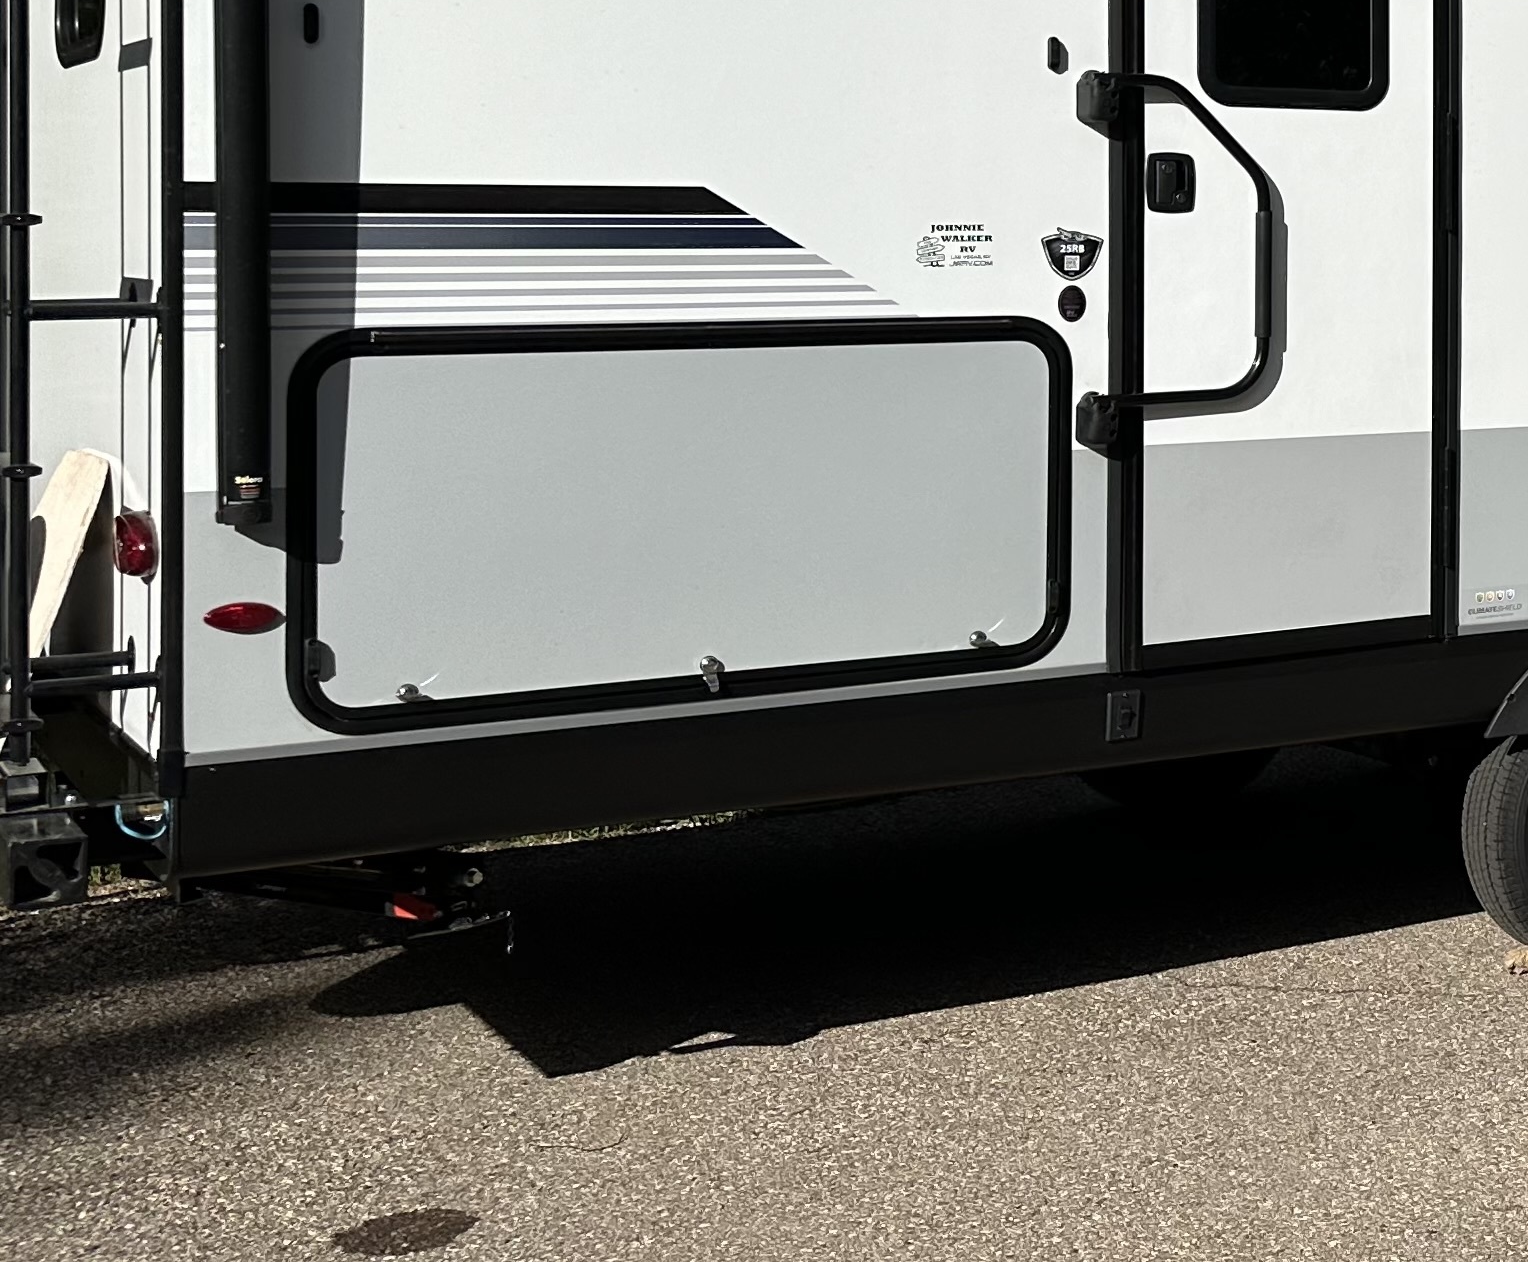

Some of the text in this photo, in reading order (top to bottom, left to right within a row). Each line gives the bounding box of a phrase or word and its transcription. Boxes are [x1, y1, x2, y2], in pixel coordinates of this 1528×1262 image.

[931, 224, 984, 233] JOHNNIE
[941, 234, 993, 243] WALKER
[960, 245, 976, 253] RV
[1060, 244, 1085, 254] 25RB
